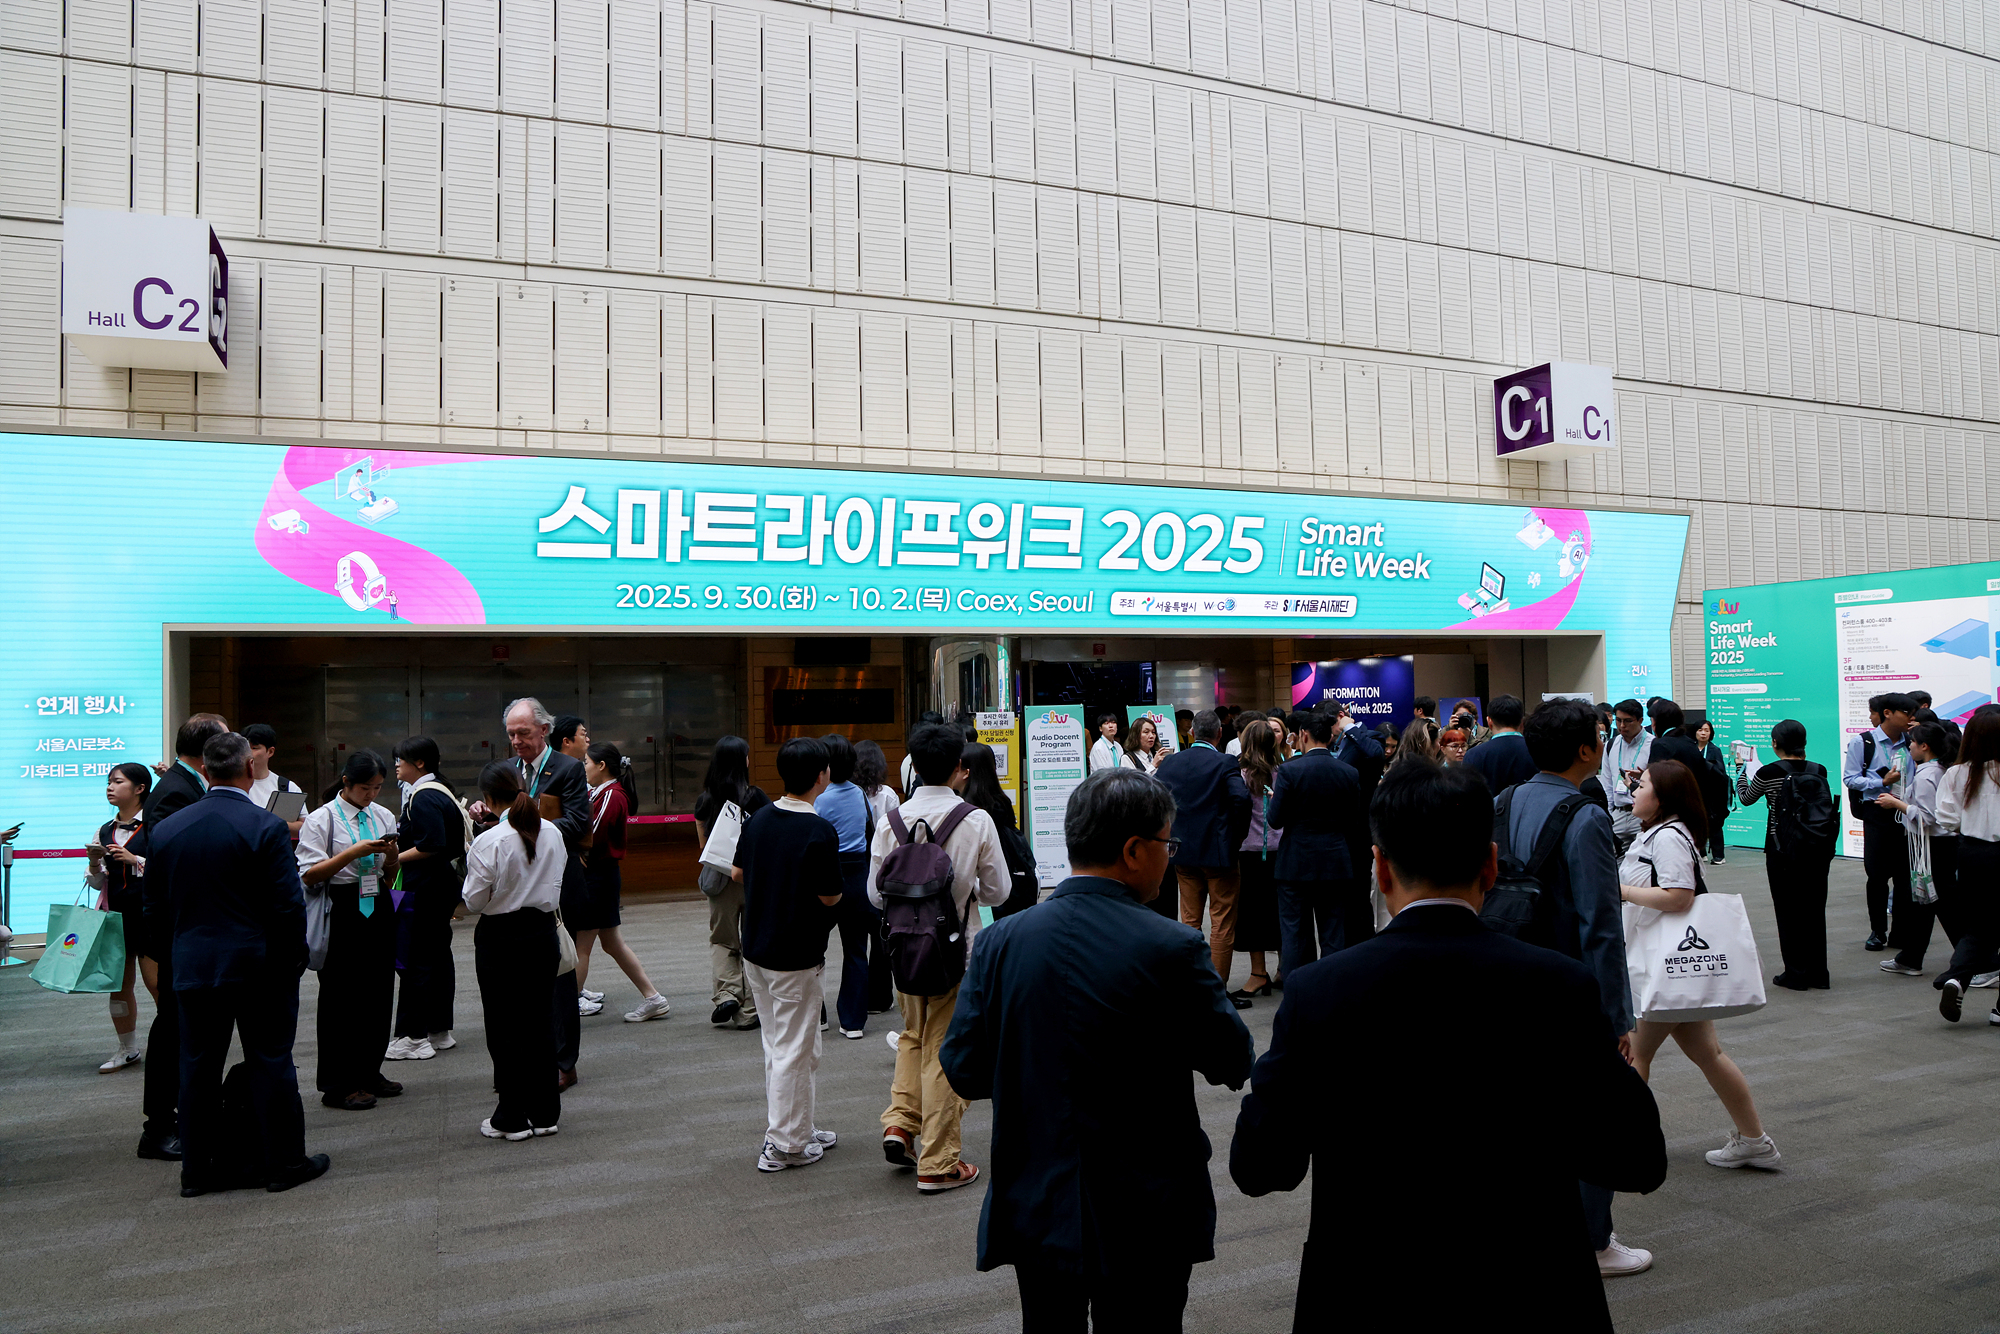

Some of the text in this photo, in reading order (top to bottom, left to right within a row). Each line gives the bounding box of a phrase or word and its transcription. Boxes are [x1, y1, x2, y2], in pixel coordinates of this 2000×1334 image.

[88, 276, 200, 333] Hall C2
[1501, 385, 1549, 441] C1
[1566, 406, 1610, 442] Hall C1
[536, 485, 1266, 575] 스마트라이프위크 2025
[1299, 517, 1385, 548] Smart
[1574, 550, 1583, 560] AI
[1296, 548, 1432, 580] Life Week
[616, 584, 697, 610] 2025.
[957, 590, 1023, 615] Coex,
[1028, 590, 1094, 613] Seoul
[1155, 602, 1196, 612] 서울특별시
[1710, 619, 1753, 635] Smart
[1710, 632, 1778, 650] Life Week
[1711, 650, 1745, 665] 2025
[1632, 665, 1648, 676] 전시
[1323, 687, 1380, 699] INFORMATION
[36, 696, 126, 716] 연계 행사
[1372, 703, 1392, 714] 2025
[35, 738, 126, 752] 서울AI로봇쇼
[20, 762, 119, 778] 기후테크 컨퍼
[1664, 954, 1727, 965] MEGAZONE
